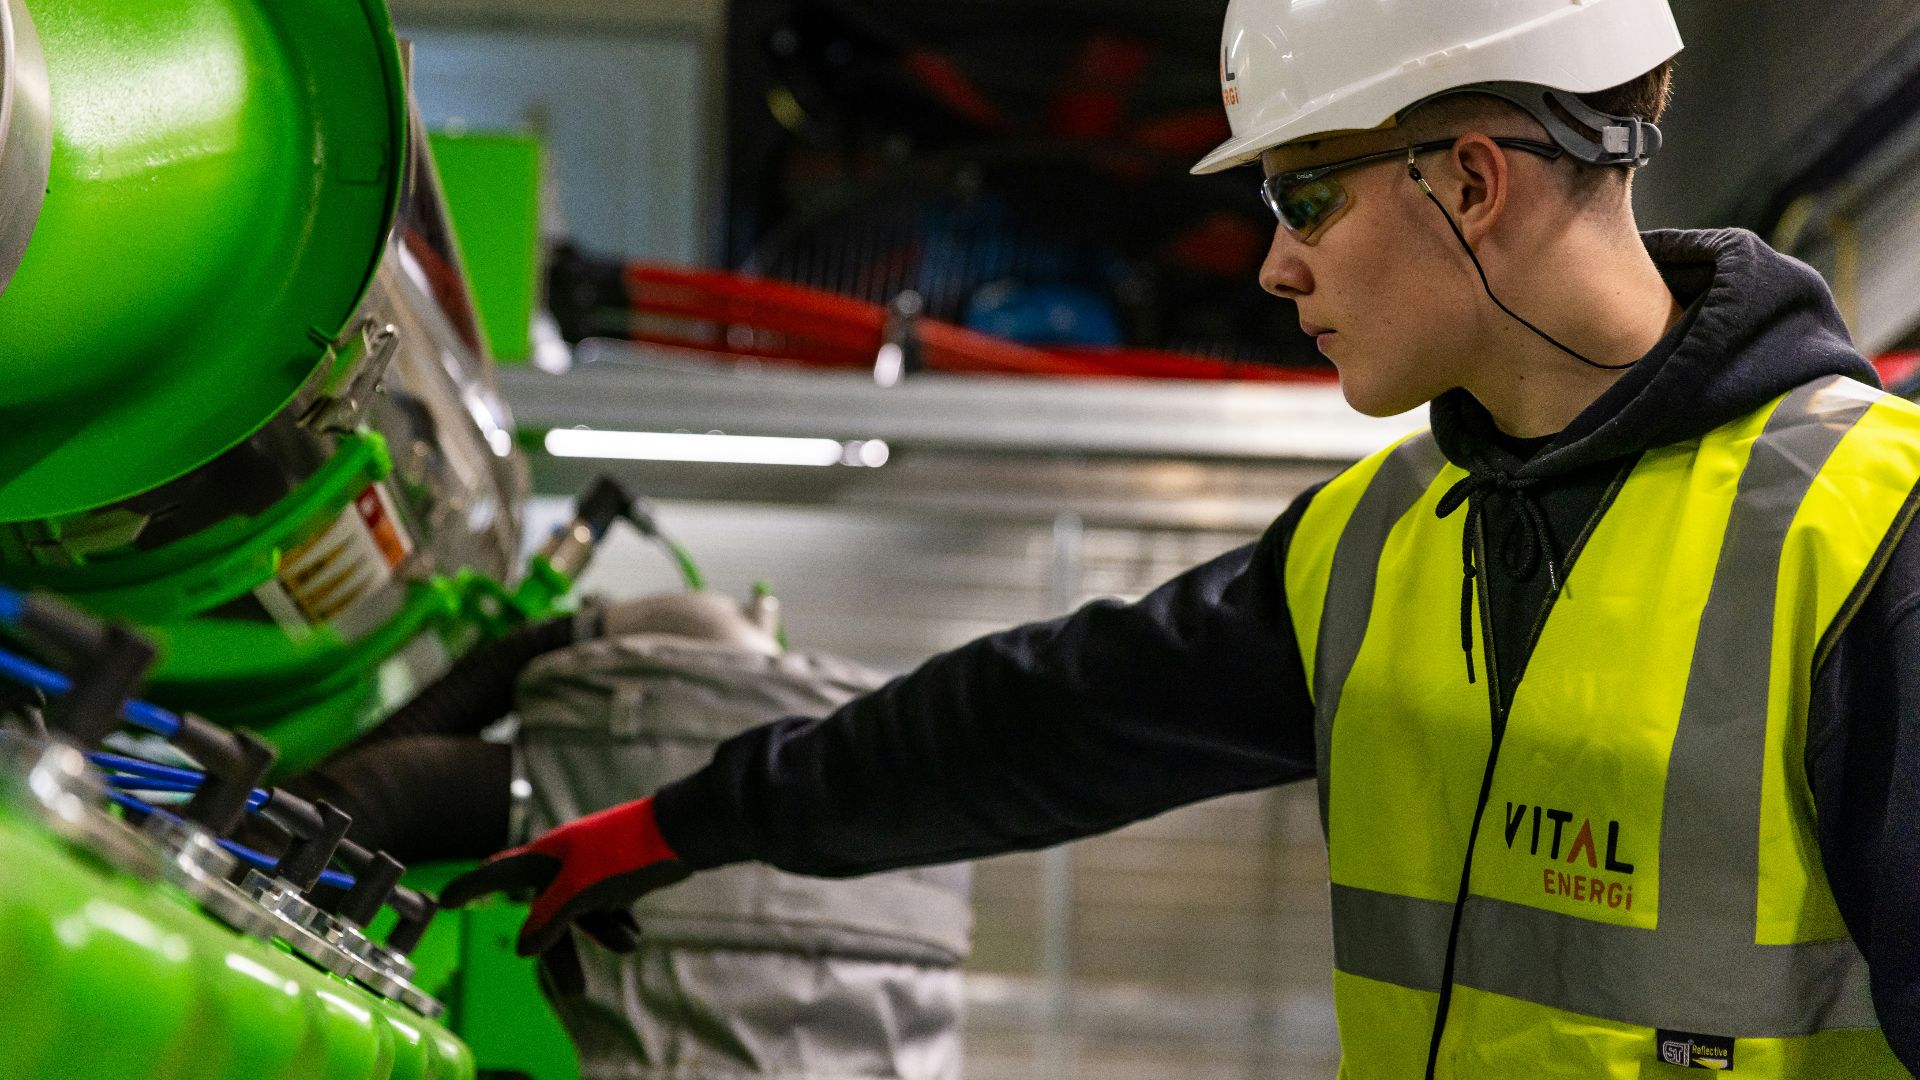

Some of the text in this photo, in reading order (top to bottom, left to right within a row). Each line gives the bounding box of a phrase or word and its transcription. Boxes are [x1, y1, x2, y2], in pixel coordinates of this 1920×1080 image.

[1505, 802, 1634, 874] VITAL
[1543, 868, 1633, 912] ENERGi
[1692, 1044, 1728, 1057] Reflective
